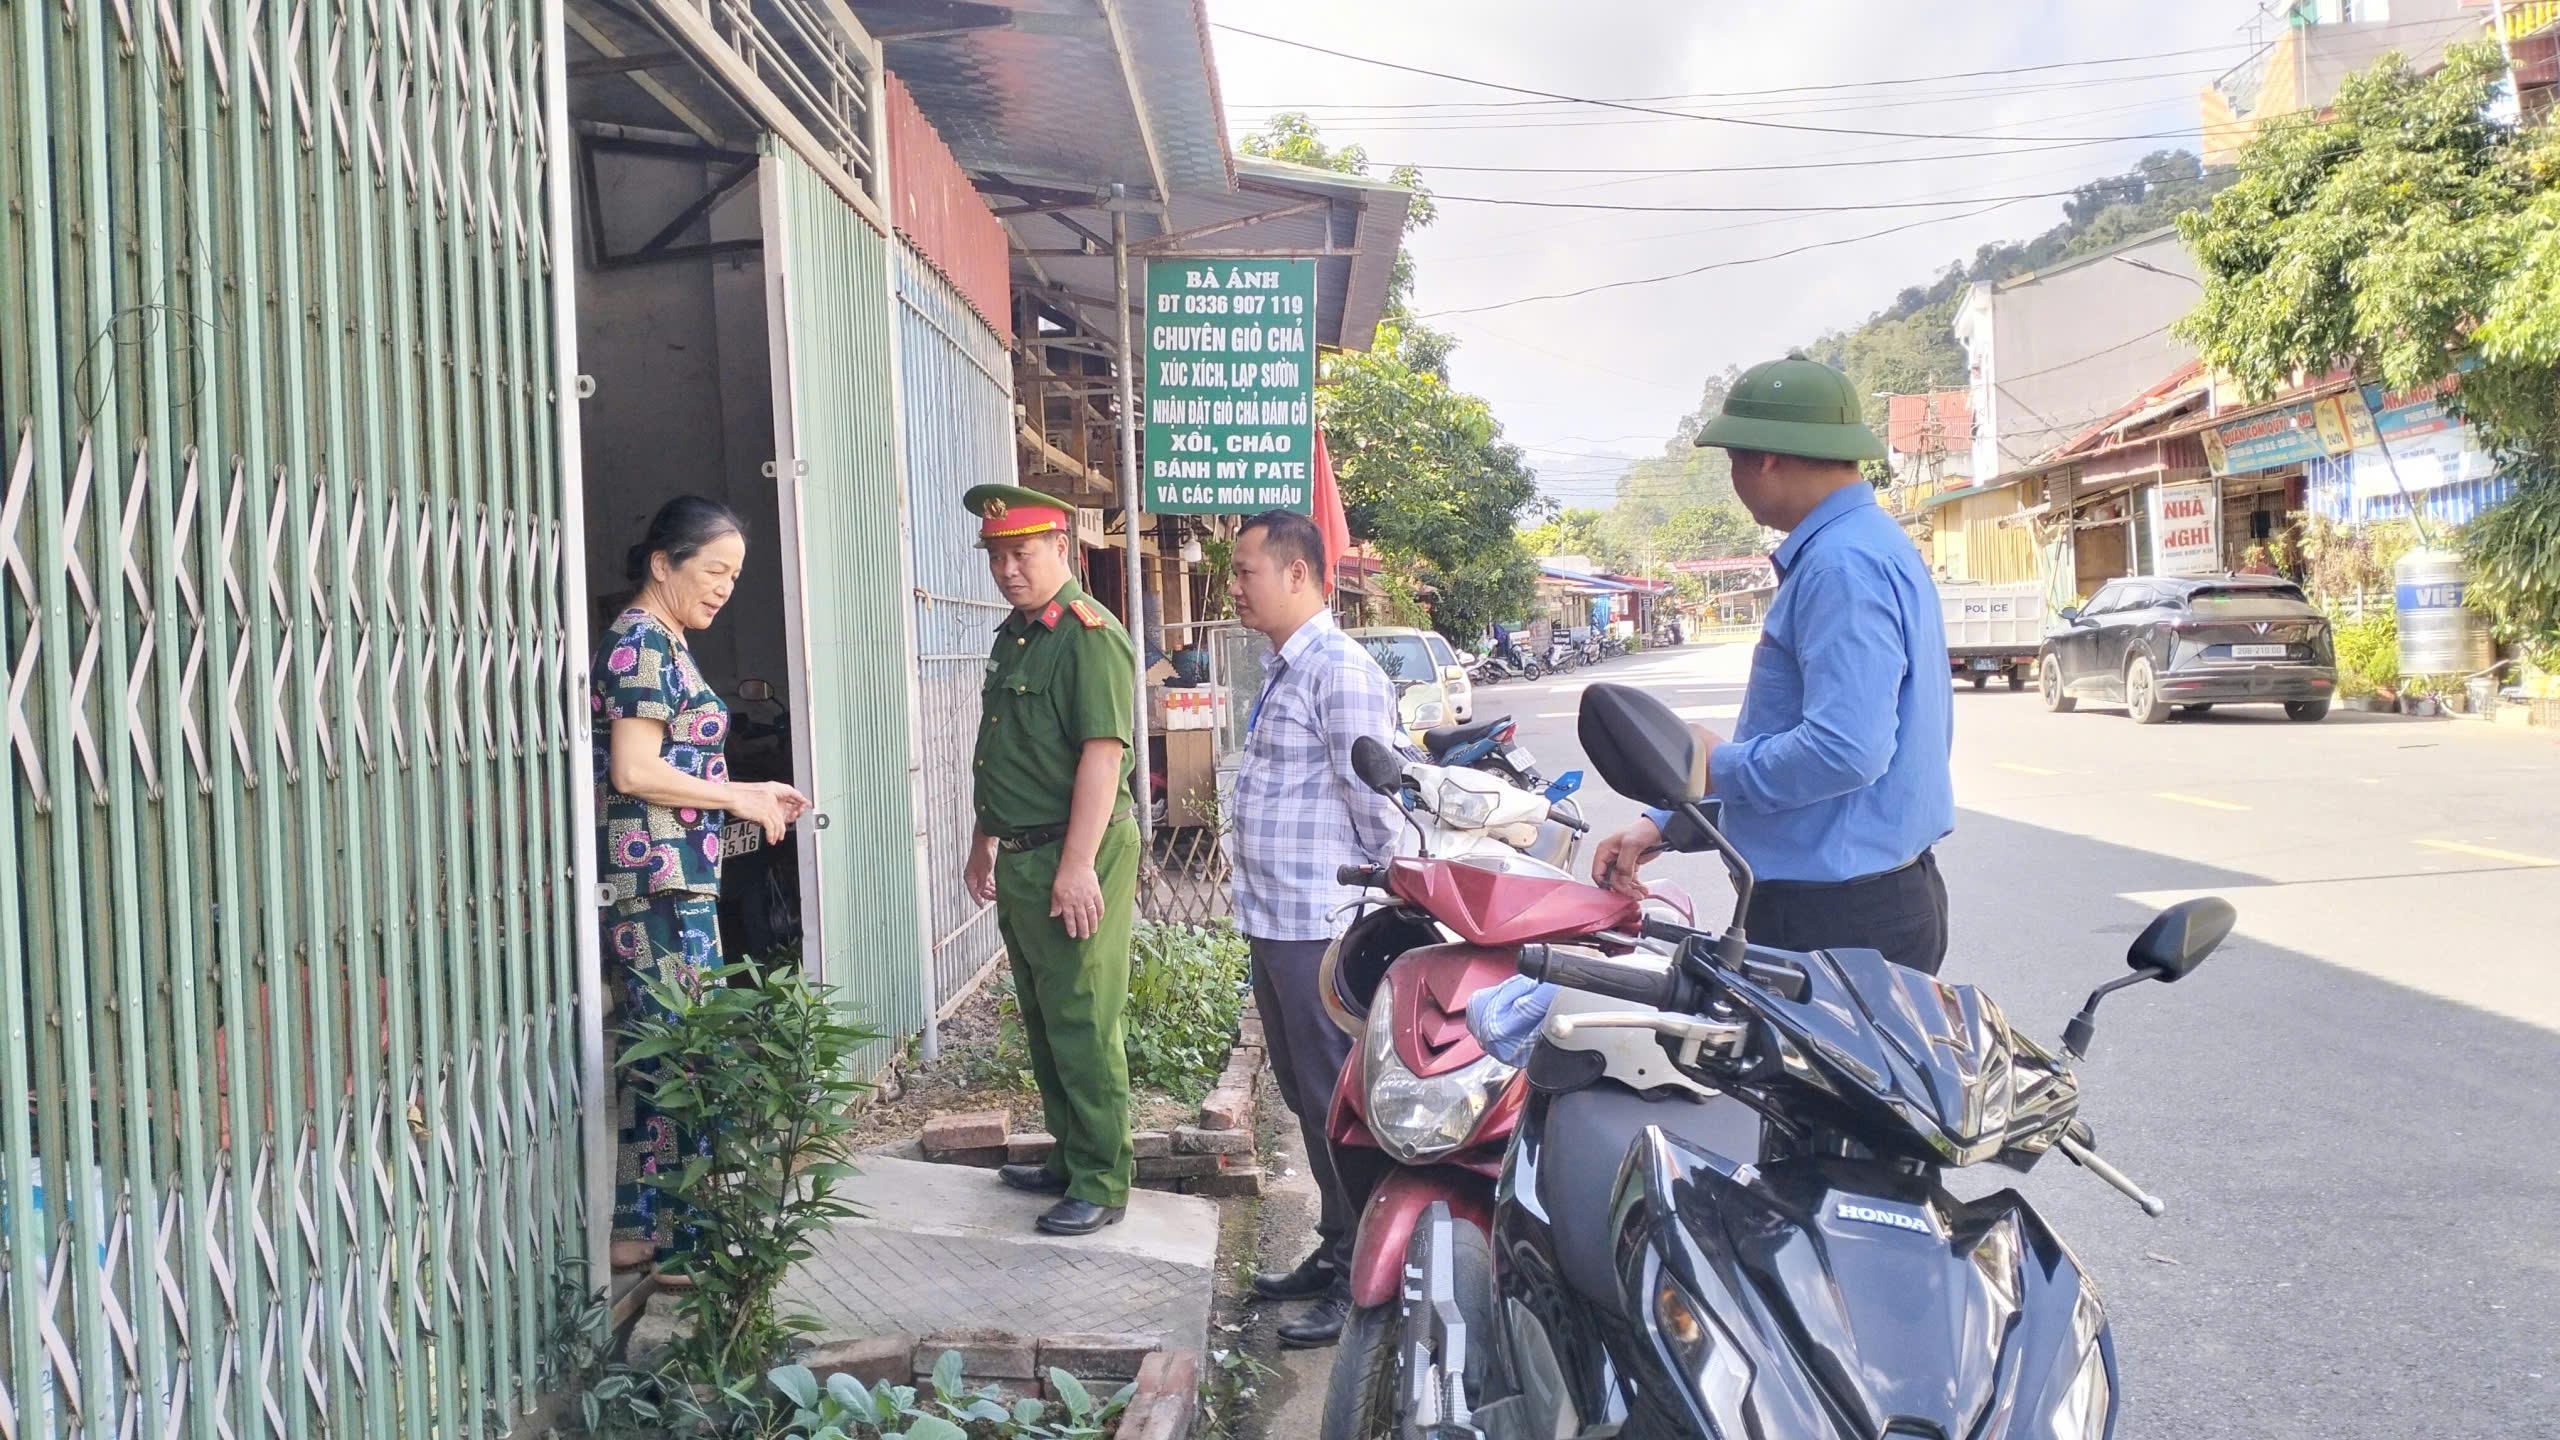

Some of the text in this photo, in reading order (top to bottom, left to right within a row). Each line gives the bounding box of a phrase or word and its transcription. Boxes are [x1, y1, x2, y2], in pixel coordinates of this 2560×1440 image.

[1186, 267, 1279, 288] BÀ ÁNH
[1158, 294, 1303, 314] ĐT 0336 907 119
[1153, 317, 1304, 352] CHUYÊN GIÒ CHẢ
[1160, 356, 1299, 392] XÚC XÍCH, LẠP SƯỜN
[1153, 391, 1307, 429] NHẬN ĐẶT GIÒ CHẢ ĐÁM CỖ
[1171, 431, 1291, 454] XÔI, CHÁO
[1154, 458, 1305, 479] BÁNH MỲ PATE
[1157, 483, 1301, 508] VÀ CÁC MÓN NHẬU
[2164, 520, 2210, 549] NGHỈ
[1965, 603, 2008, 613] POLICE
[1838, 1204, 1931, 1234] HONDA
